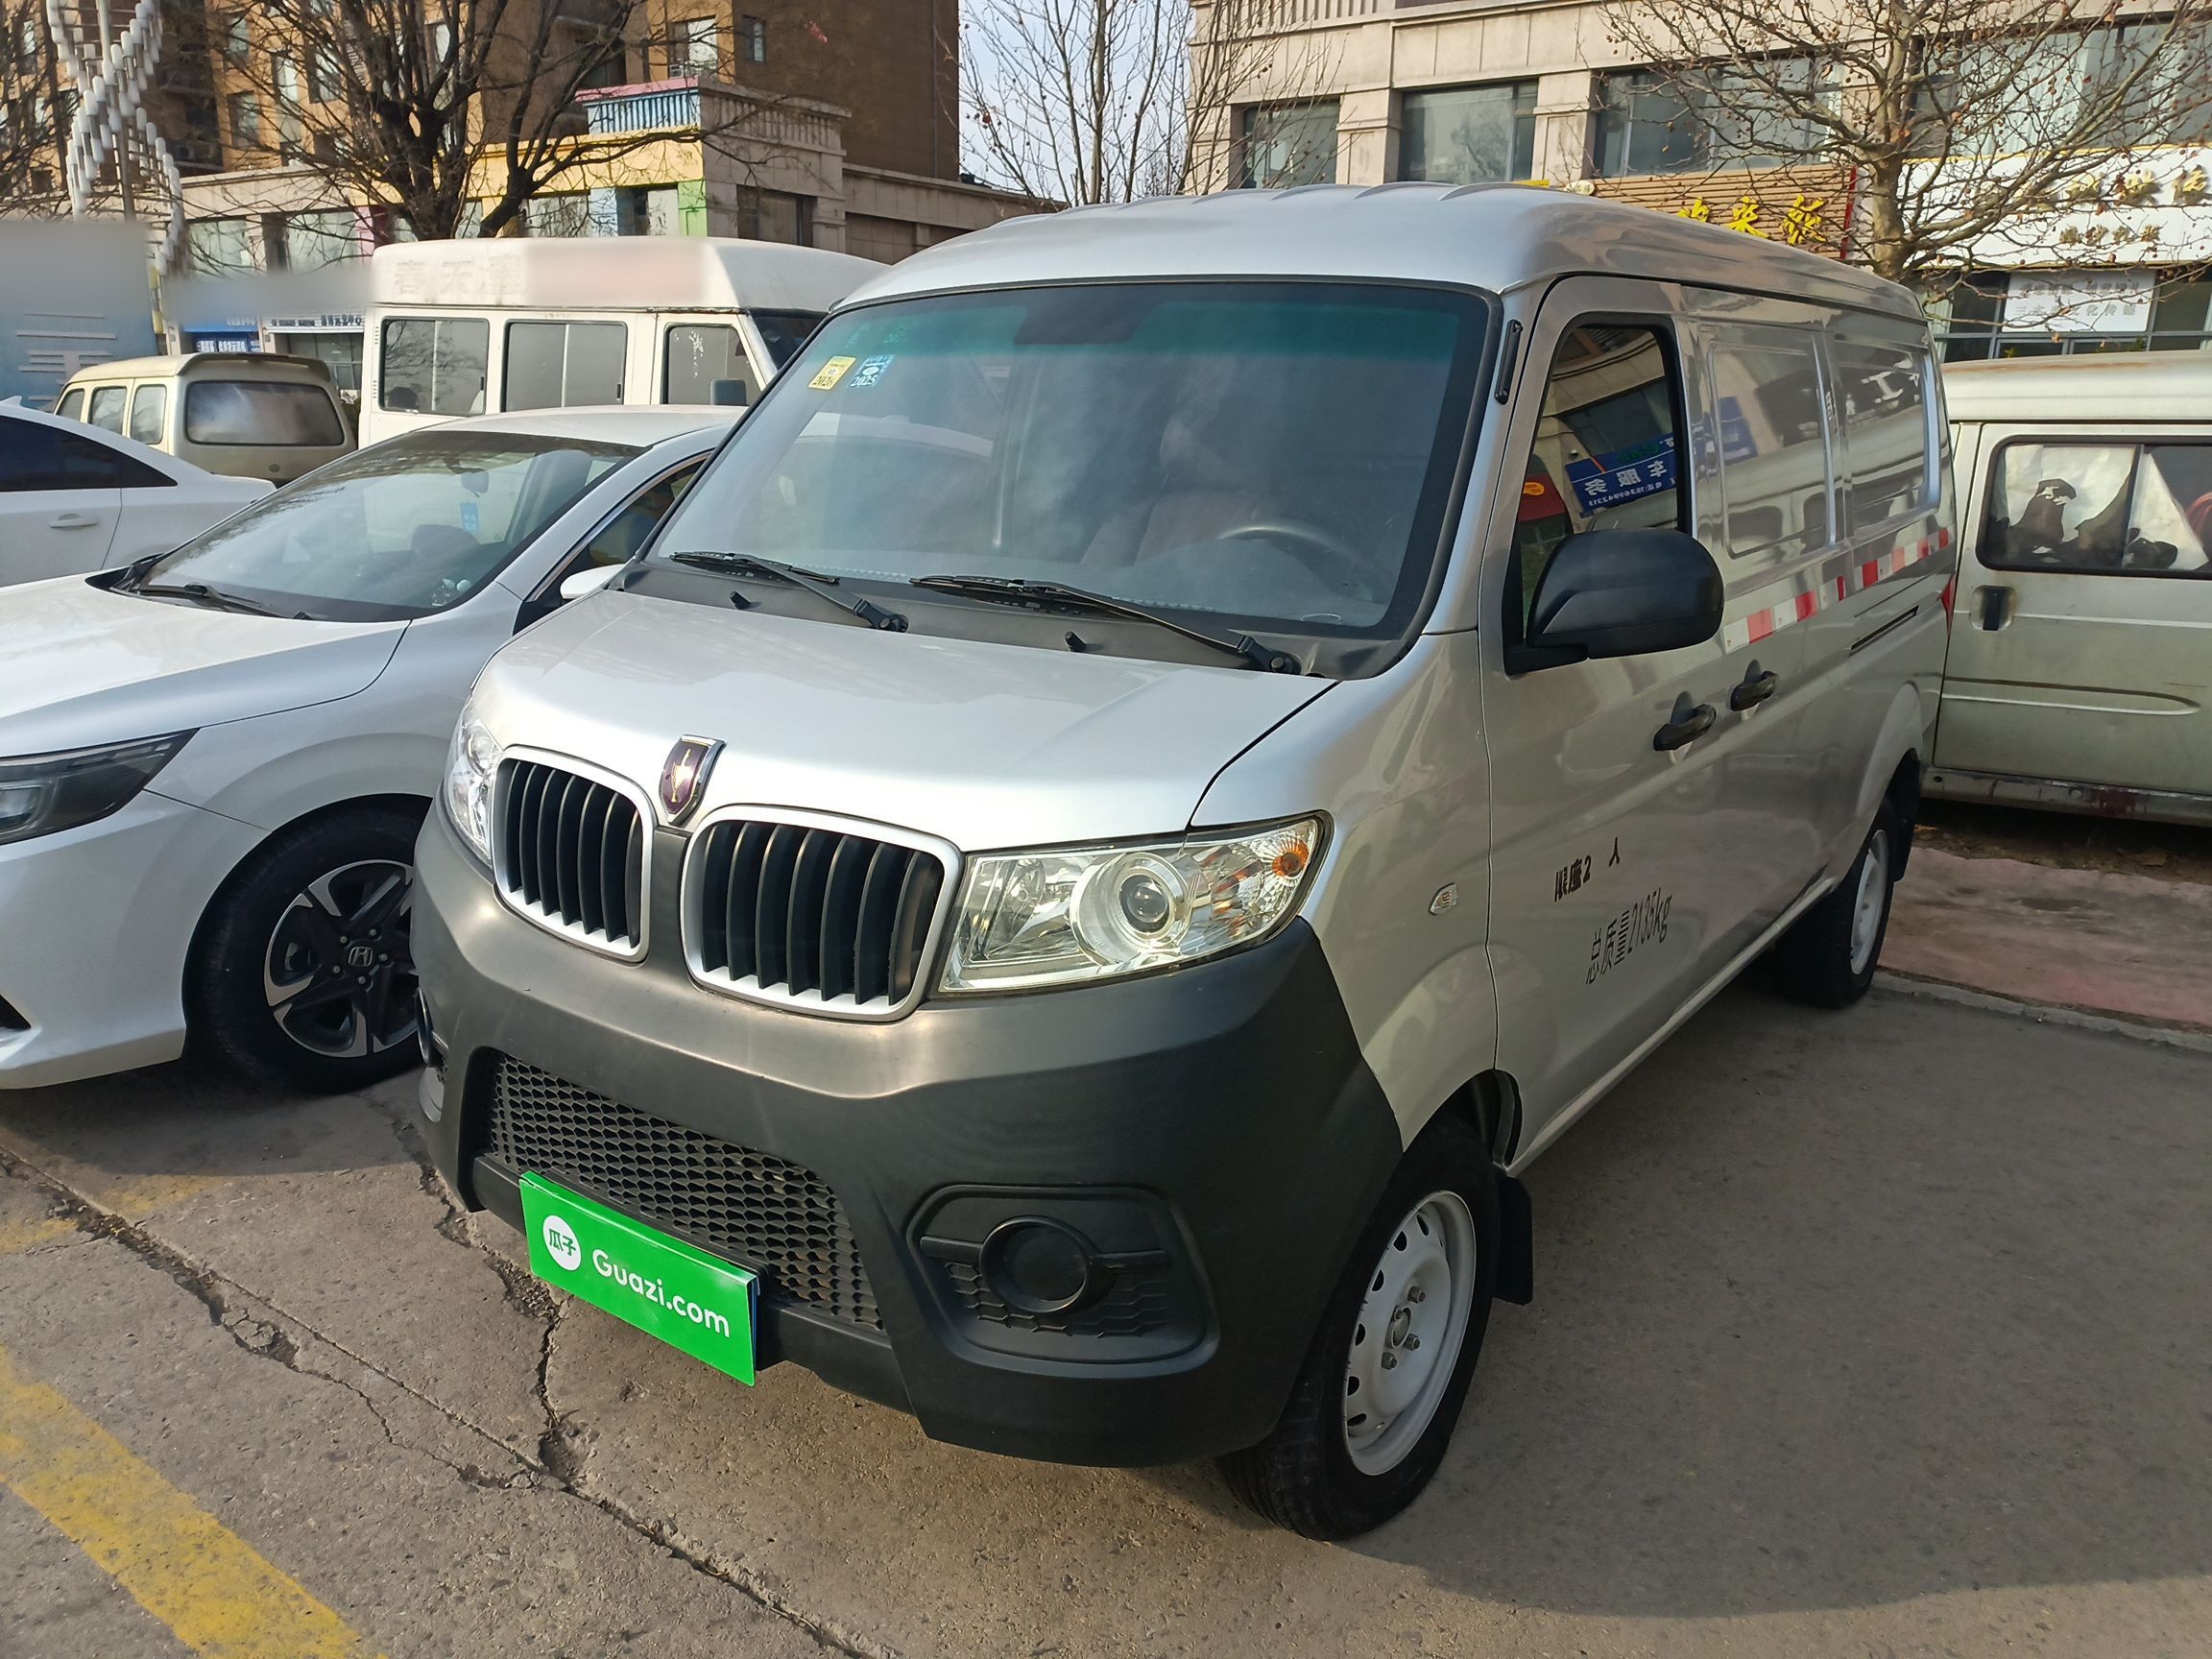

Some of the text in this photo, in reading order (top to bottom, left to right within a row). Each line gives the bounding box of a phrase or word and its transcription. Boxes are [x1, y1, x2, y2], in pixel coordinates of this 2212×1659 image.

[850, 375, 878, 387] 2025
[548, 1227, 577, 1257] 瓜子
[591, 1249, 731, 1338] Guazi.com
